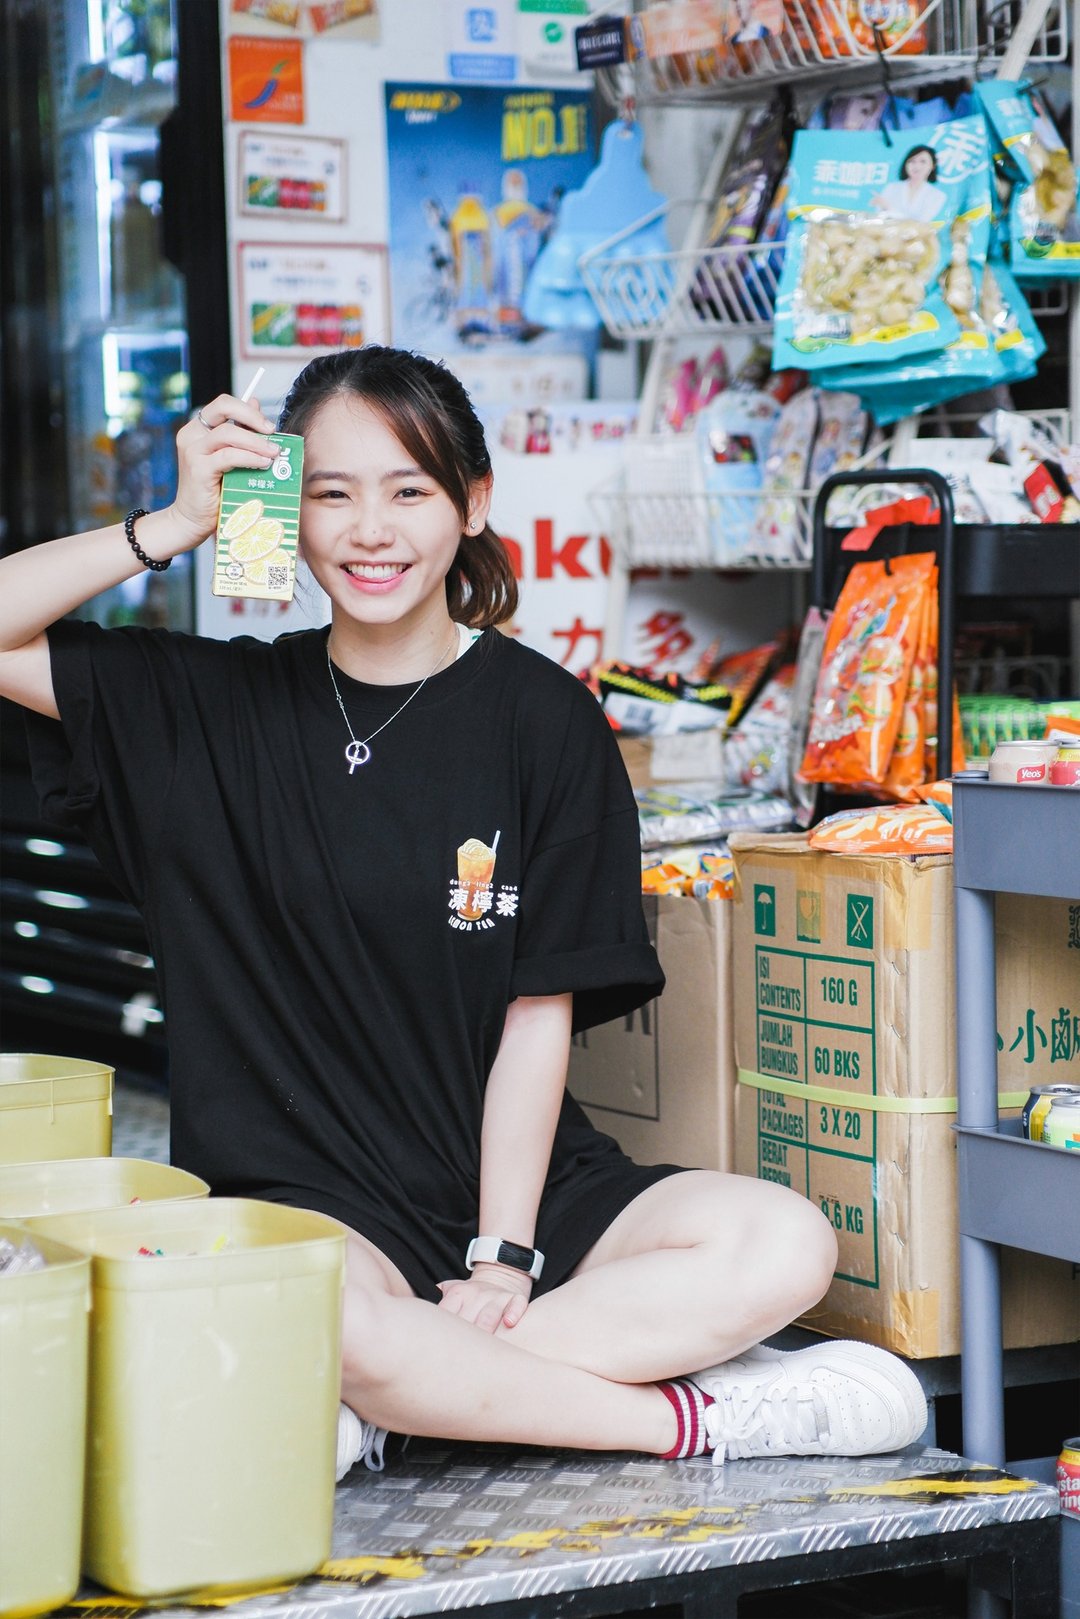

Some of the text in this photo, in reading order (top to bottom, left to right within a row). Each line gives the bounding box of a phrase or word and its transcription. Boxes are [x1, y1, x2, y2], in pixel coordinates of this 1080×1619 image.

[247, 478, 275, 489] 檸檬茶
[1021, 769, 1042, 779] Yeo's
[448, 888, 519, 917] 凍檸茶
[448, 915, 495, 931] LEMON TEA
[760, 956, 770, 979] ISI
[760, 982, 801, 1012] CONTENTS
[821, 976, 858, 1006] 160 G
[761, 1020, 793, 1047] JUMLAH
[761, 1045, 799, 1075] BUNGKUS
[814, 1046, 860, 1079] 60 BKS
[762, 1107, 804, 1139] PACKAGES
[820, 1106, 860, 1140] 3 X 20
[762, 1140, 788, 1167] BERAT
[845, 1204, 864, 1234] KG
